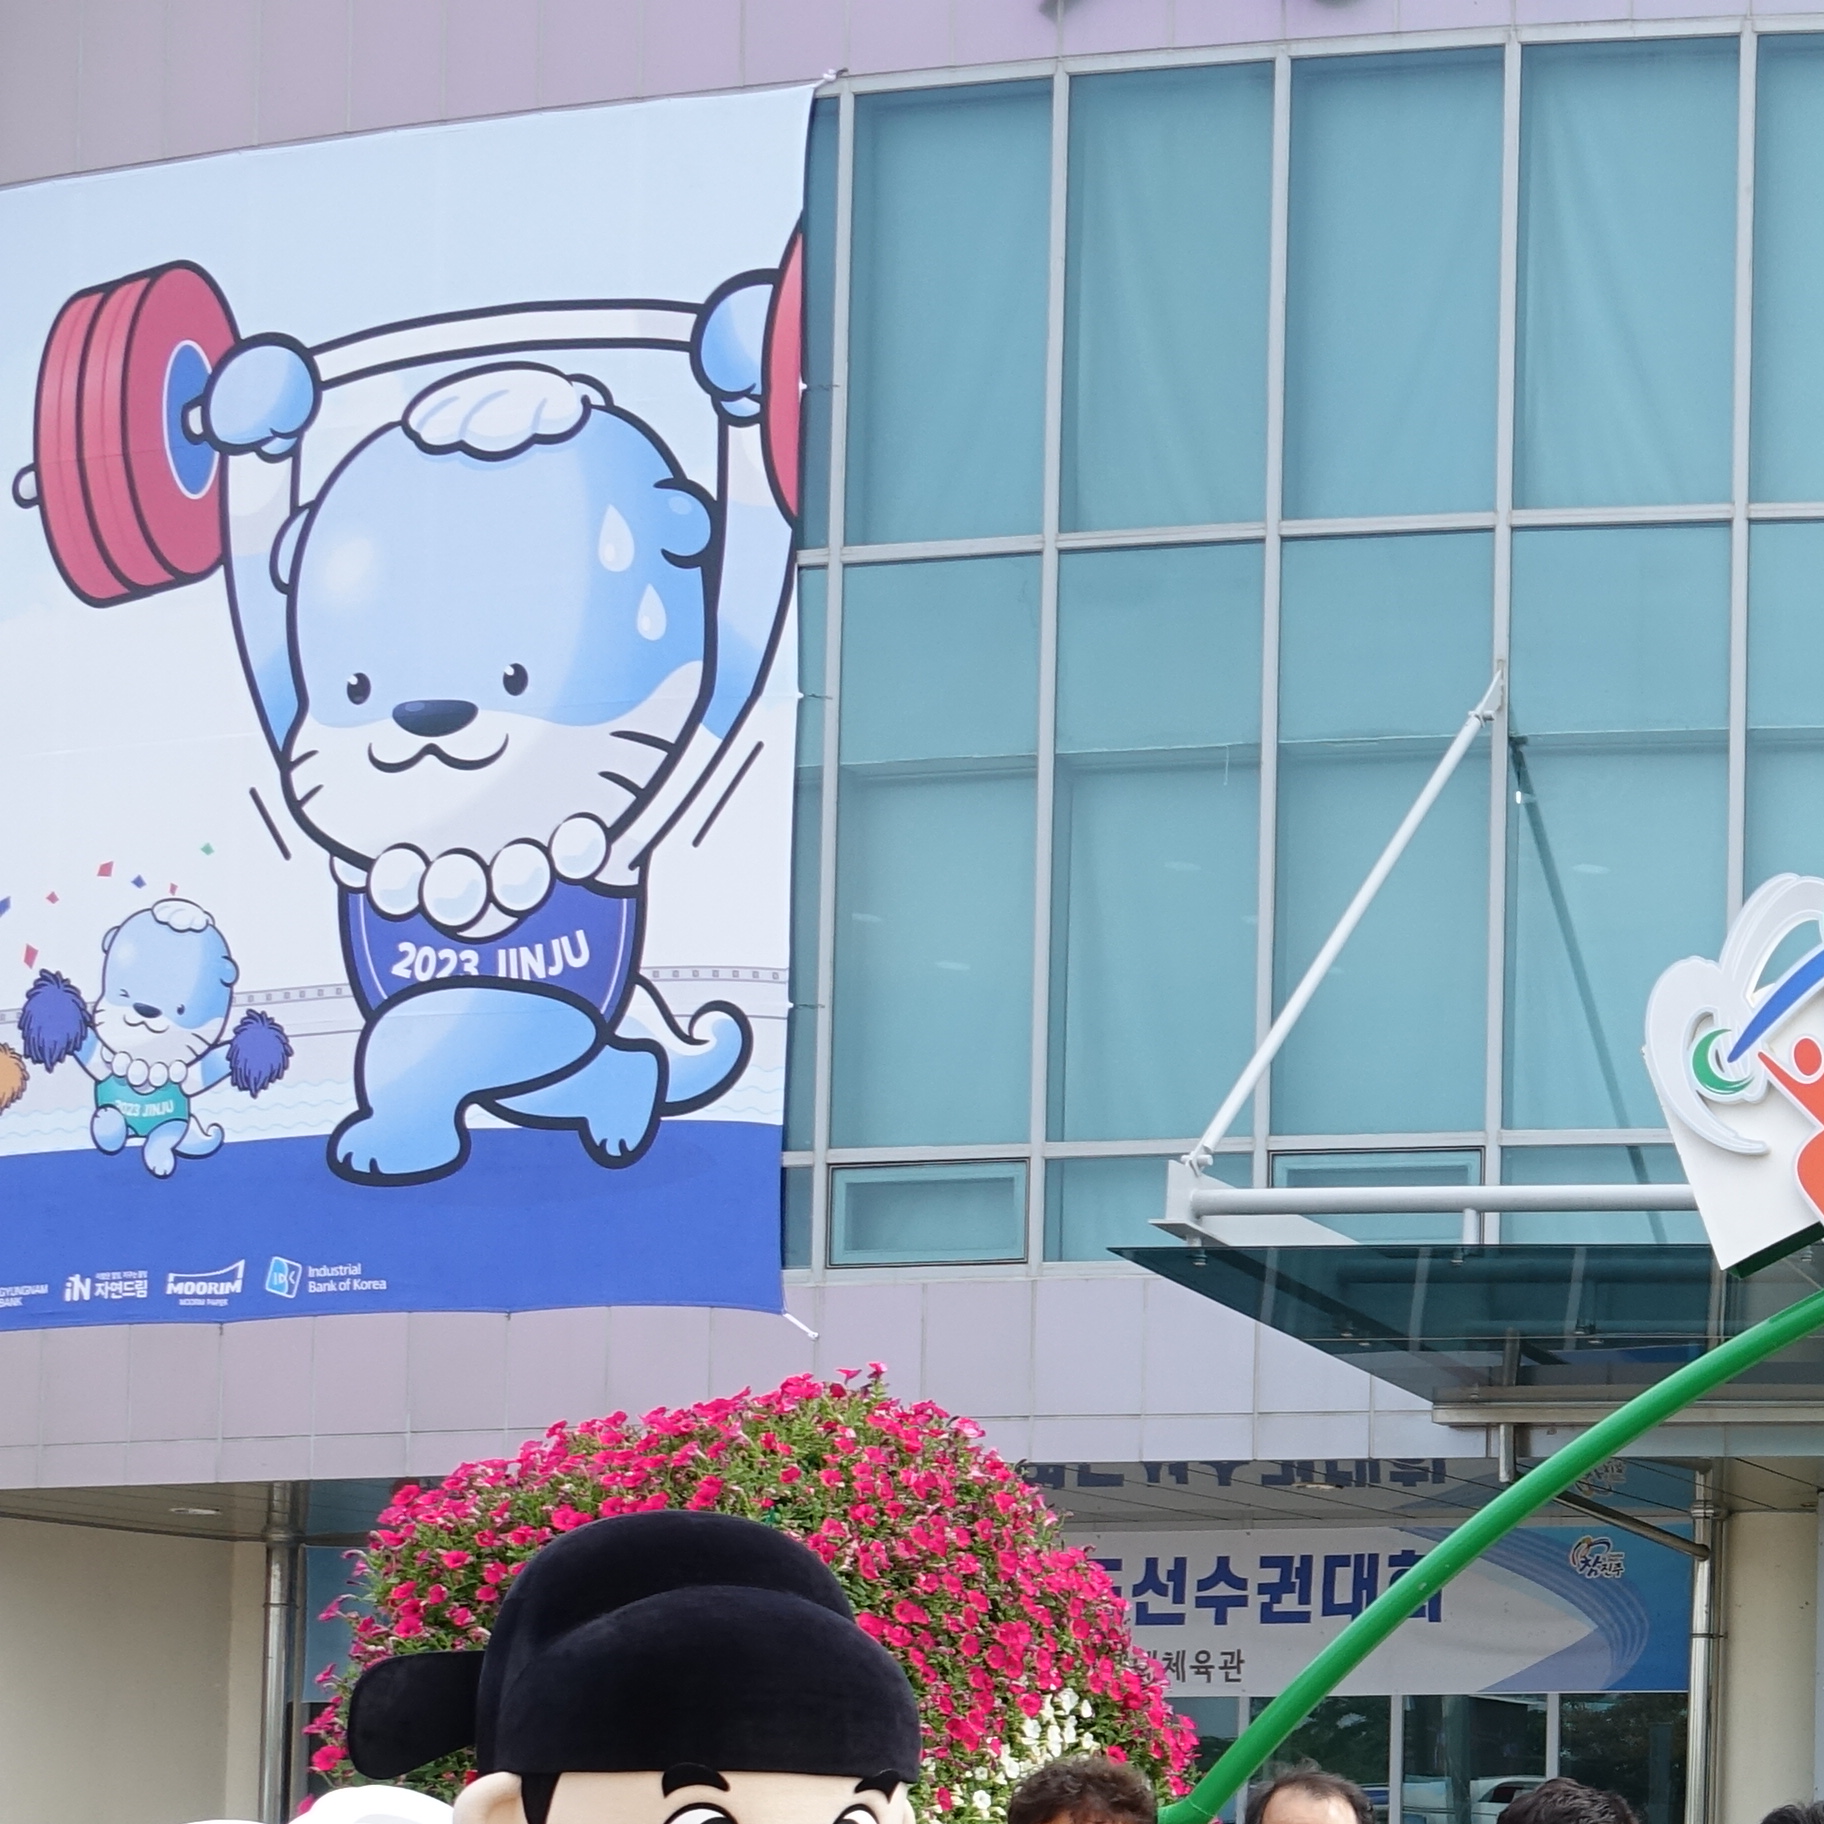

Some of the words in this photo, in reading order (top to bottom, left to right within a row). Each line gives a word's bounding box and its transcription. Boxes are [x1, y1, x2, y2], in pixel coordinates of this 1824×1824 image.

[391, 941, 481, 981] 2023
[497, 928, 592, 980] JINJU
[308, 1263, 362, 1277] Industrial
[94, 1279, 148, 1300] 자연드림
[166, 1280, 243, 1296] MOORIM
[308, 1278, 337, 1293] Bank
[339, 1278, 351, 1292] of
[352, 1277, 387, 1291] Korea
